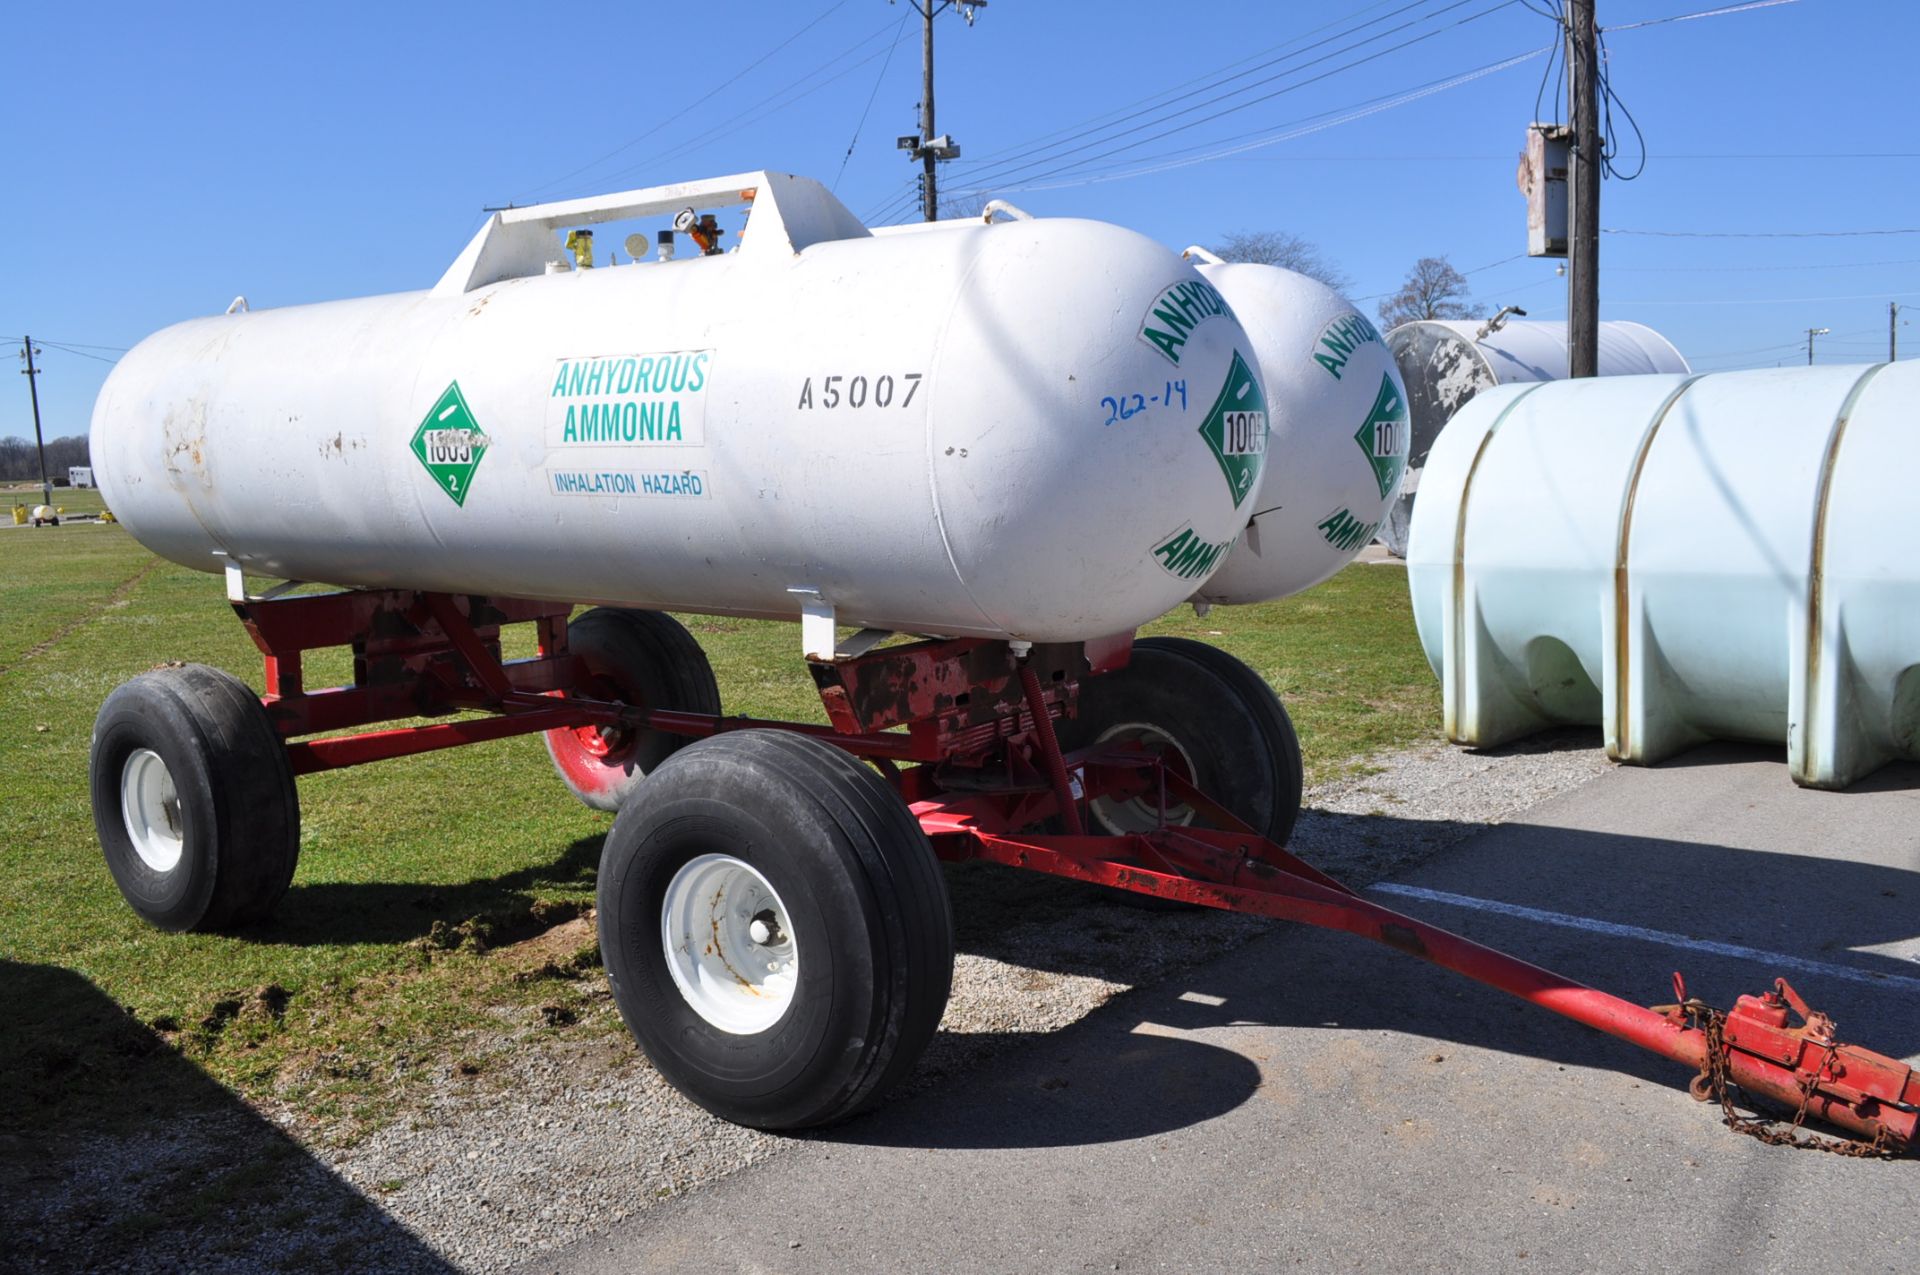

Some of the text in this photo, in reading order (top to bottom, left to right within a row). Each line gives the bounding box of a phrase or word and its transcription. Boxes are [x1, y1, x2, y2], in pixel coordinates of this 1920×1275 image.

[552, 353, 708, 397] ANHYDROUS
[798, 373, 922, 410] A5007
[1101, 379, 1186, 426] 262-14
[563, 401, 682, 442] AMMONIA
[448, 474, 459, 491] 2
[555, 473, 702, 495] INHALATION HAZARD
[1238, 468, 1248, 489] 2
[1384, 467, 1393, 484] 2
